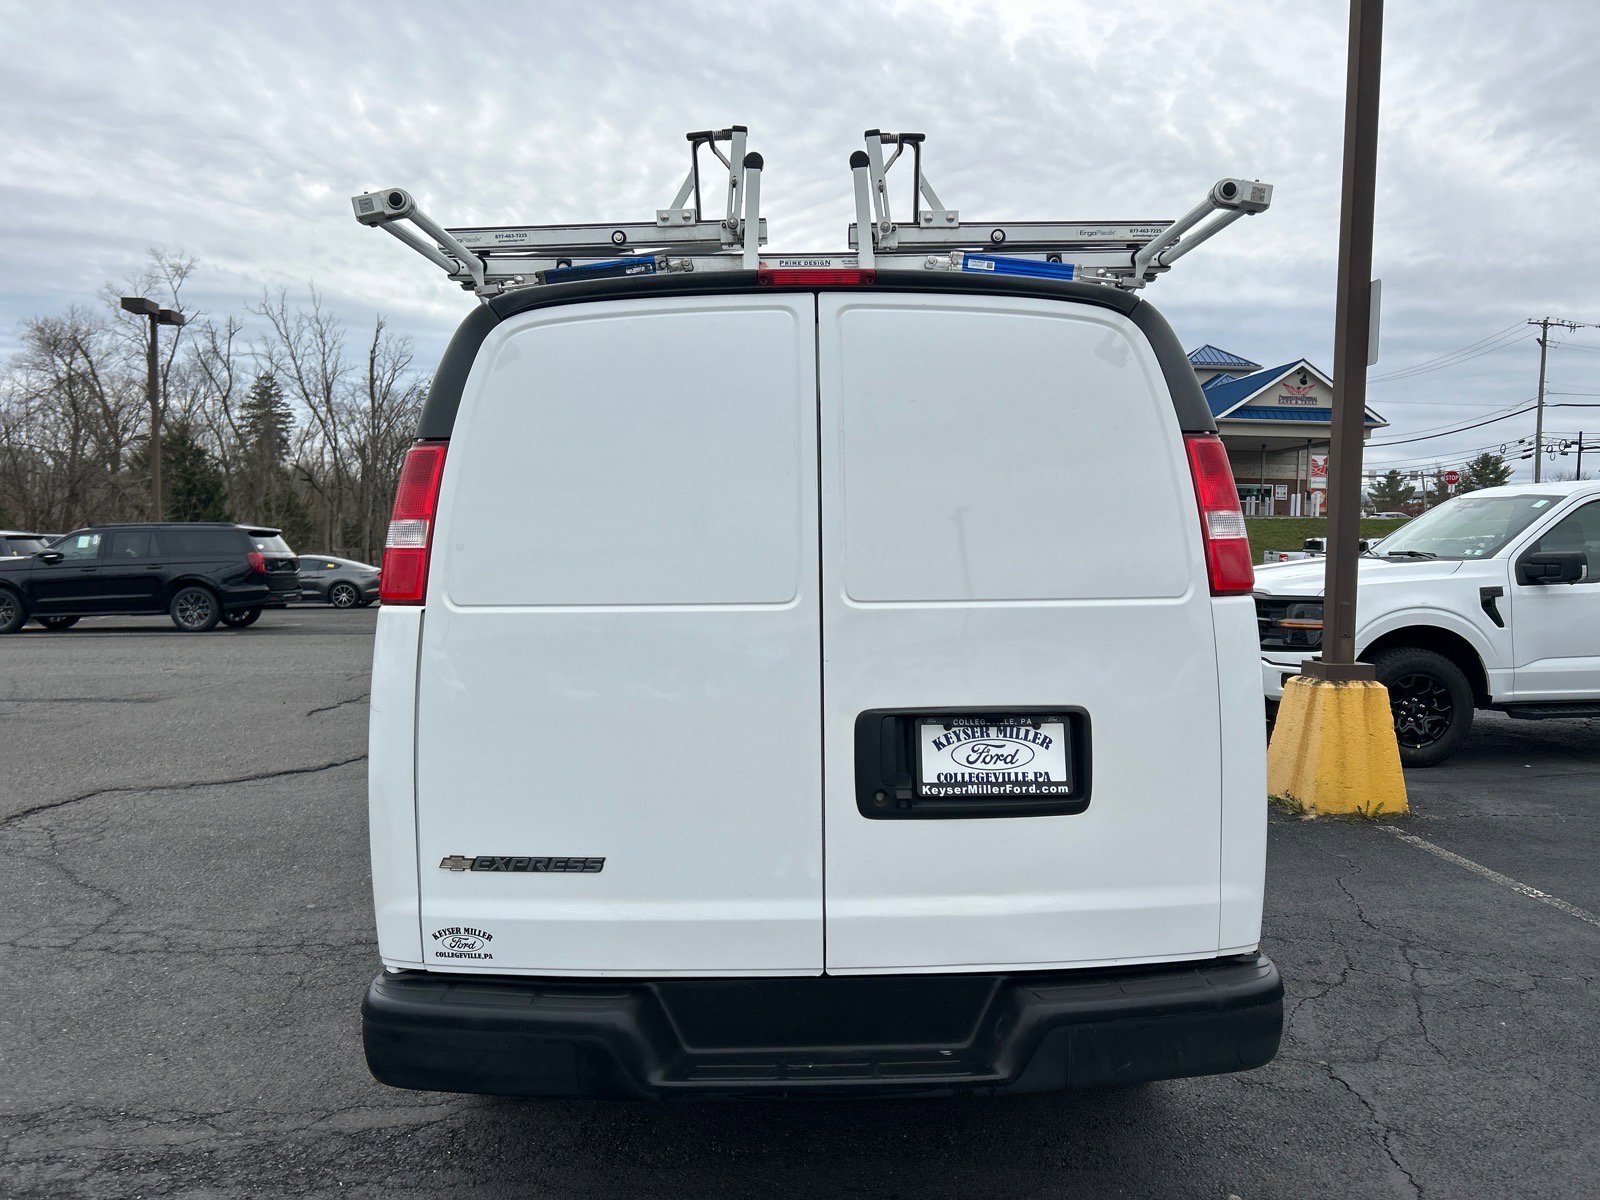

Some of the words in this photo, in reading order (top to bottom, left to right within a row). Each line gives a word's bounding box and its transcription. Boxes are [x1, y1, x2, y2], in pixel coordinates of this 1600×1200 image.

[932, 727, 991, 751] KEYSER
[995, 727, 1053, 751] MILLER
[966, 742, 1020, 765] Ford
[922, 784, 1069, 796] KeyserMillerFord.com
[472, 856, 605, 872] EXPRESS
[432, 927, 461, 941] KEYSER
[464, 927, 493, 942] MILLER
[450, 936, 477, 949] Ford
